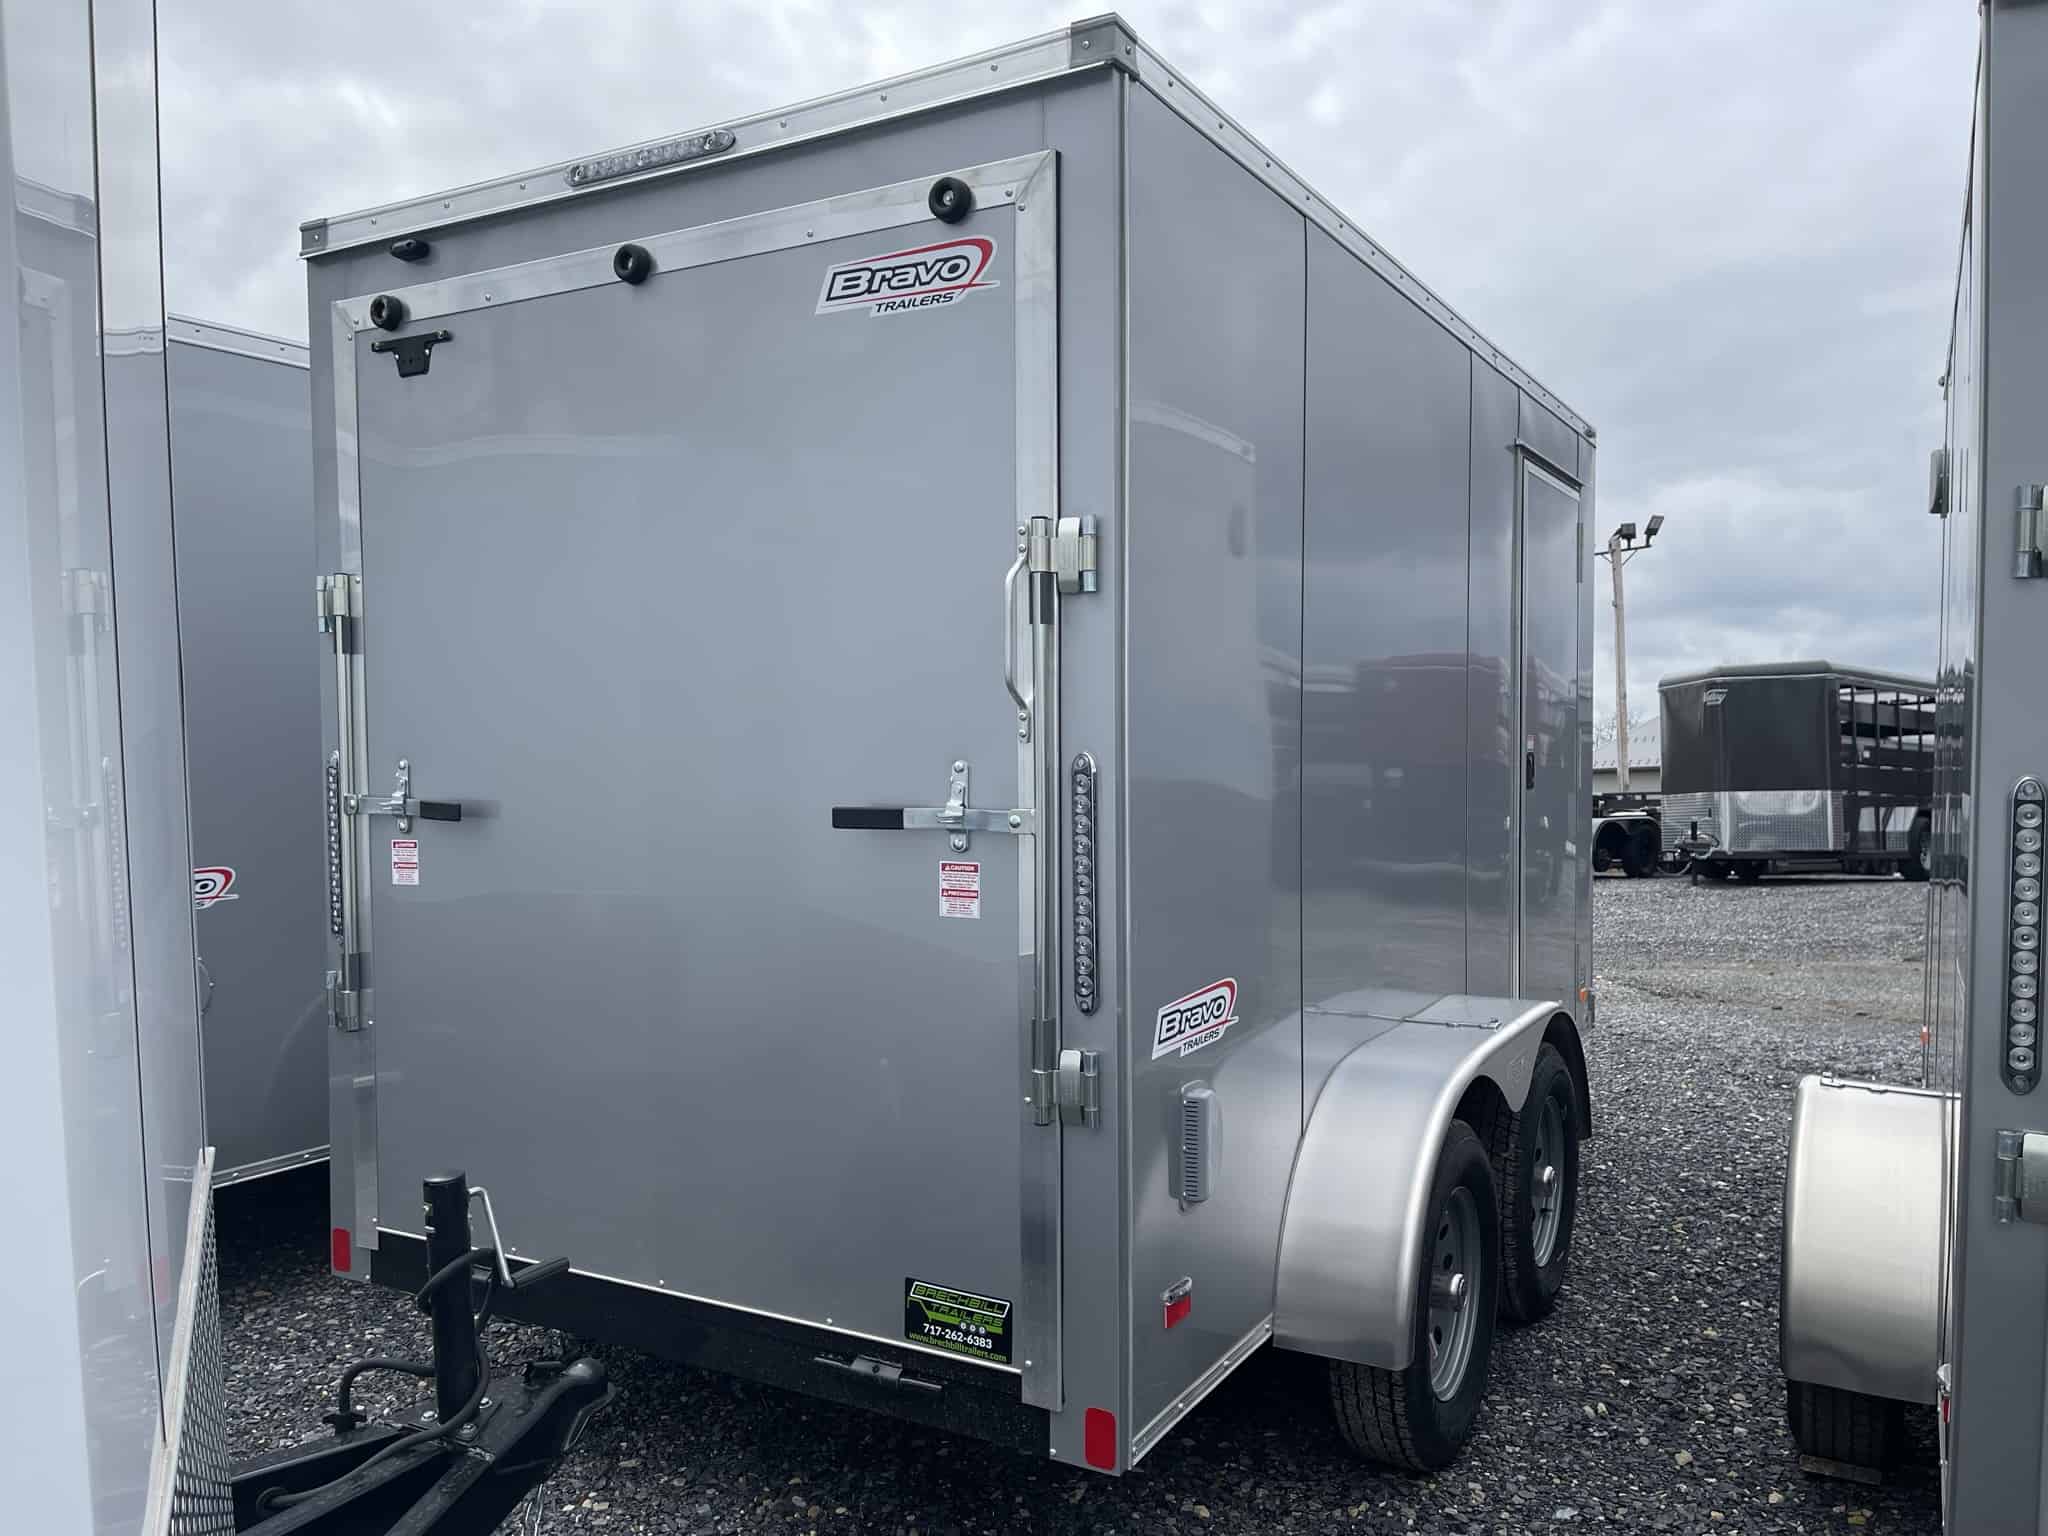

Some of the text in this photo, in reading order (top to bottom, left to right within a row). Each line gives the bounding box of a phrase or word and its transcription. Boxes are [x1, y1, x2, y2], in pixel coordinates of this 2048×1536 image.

[826, 255, 971, 302] Bravo
[874, 292, 954, 313] TRAILERS
[1158, 995, 1227, 1045] Bravo
[1183, 1028, 1220, 1052] TRAILERS
[914, 1285, 1004, 1314] BRECHBILL
[931, 1303, 1004, 1327] TRAILERS
[909, 1332, 1008, 1361] www.brechbilltrailers.com
[923, 1323, 993, 1349] 717-262-6383
